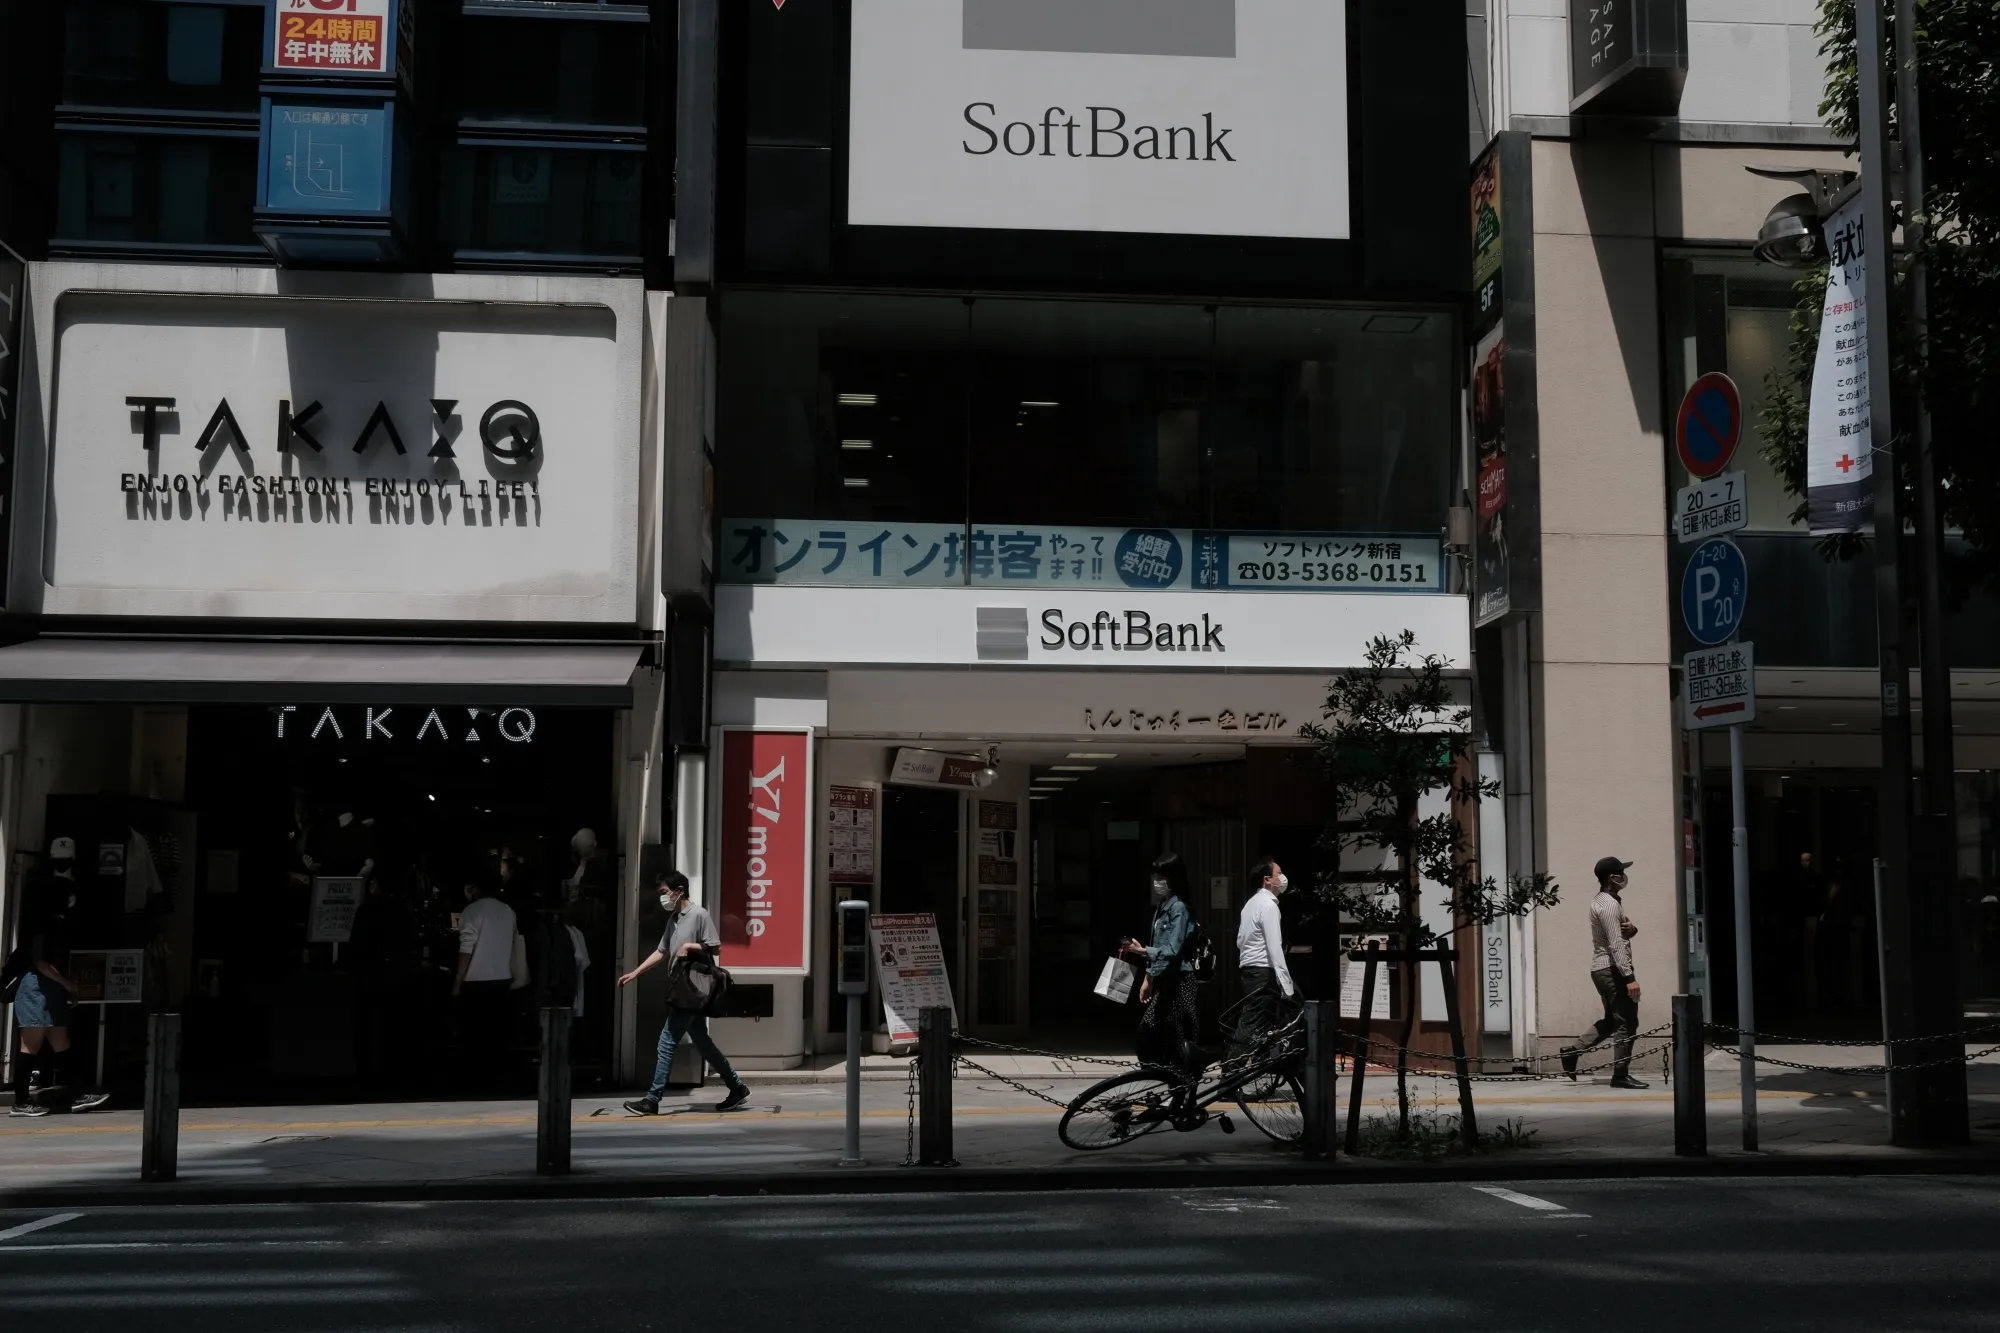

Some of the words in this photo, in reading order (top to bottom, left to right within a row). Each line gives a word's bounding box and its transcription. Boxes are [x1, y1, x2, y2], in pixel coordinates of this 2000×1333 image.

[285, 17, 377, 42] 24時間
[284, 39, 375, 65] 年中無休
[962, 102, 1237, 162] SoftBank
[1481, 279, 1494, 312] 5F
[121, 473, 206, 493] ENJOY
[218, 475, 350, 497] FASHION!
[365, 477, 449, 498] ENJOY
[459, 479, 541, 499] LIFE!
[1687, 490, 1704, 512] 20
[1725, 481, 1734, 501] 7
[732, 525, 1042, 579] オンライン接客
[1050, 533, 1104, 556] やって
[1134, 533, 1172, 562] 絶賛
[1263, 541, 1402, 560] ソフトバンク新宿
[1699, 544, 1727, 565] 7-20
[1120, 550, 1173, 584] 受付中
[1261, 561, 1427, 583] 03-5368-0151
[1695, 565, 1721, 631] P
[1714, 596, 1733, 627] 20
[1040, 608, 1226, 652] SoftBank
[910, 763, 936, 774] SoftBank
[745, 756, 785, 937] Y!mobile
[1487, 936, 1503, 1008] SoftBank
